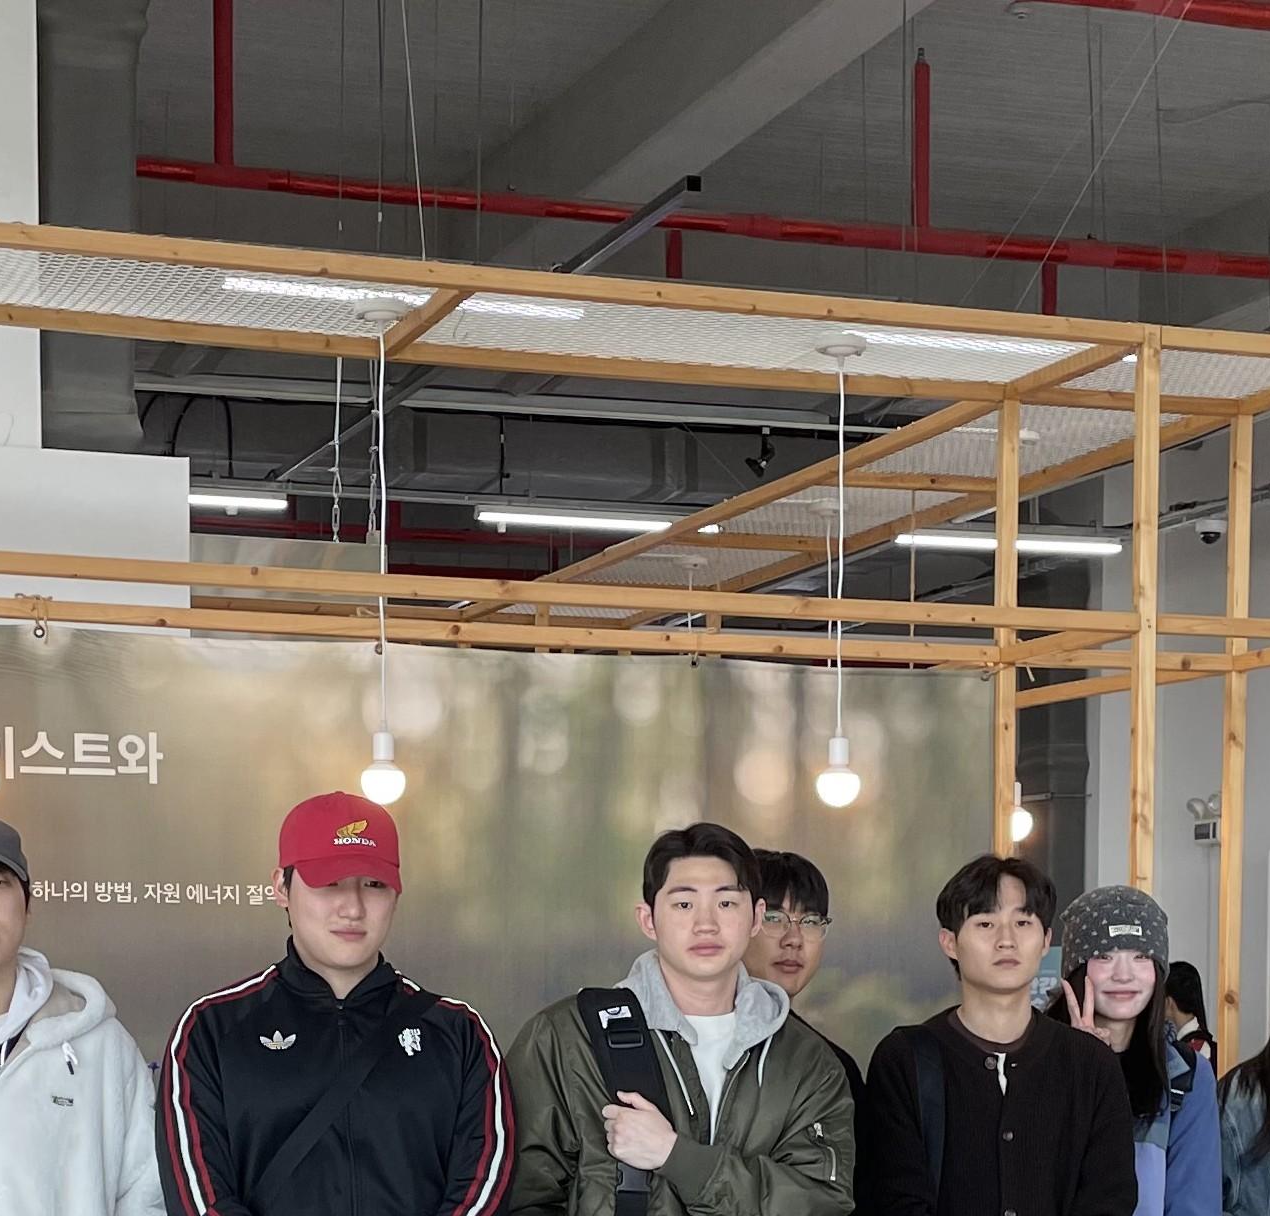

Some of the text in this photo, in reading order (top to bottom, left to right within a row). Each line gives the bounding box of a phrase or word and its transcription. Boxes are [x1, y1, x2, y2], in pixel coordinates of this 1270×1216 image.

[333, 837, 377, 848] HONDA
[31, 880, 88, 902] 하나의
[94, 882, 137, 904] 방법,
[143, 882, 180, 904] 자원
[186, 884, 239, 905] 에너지
